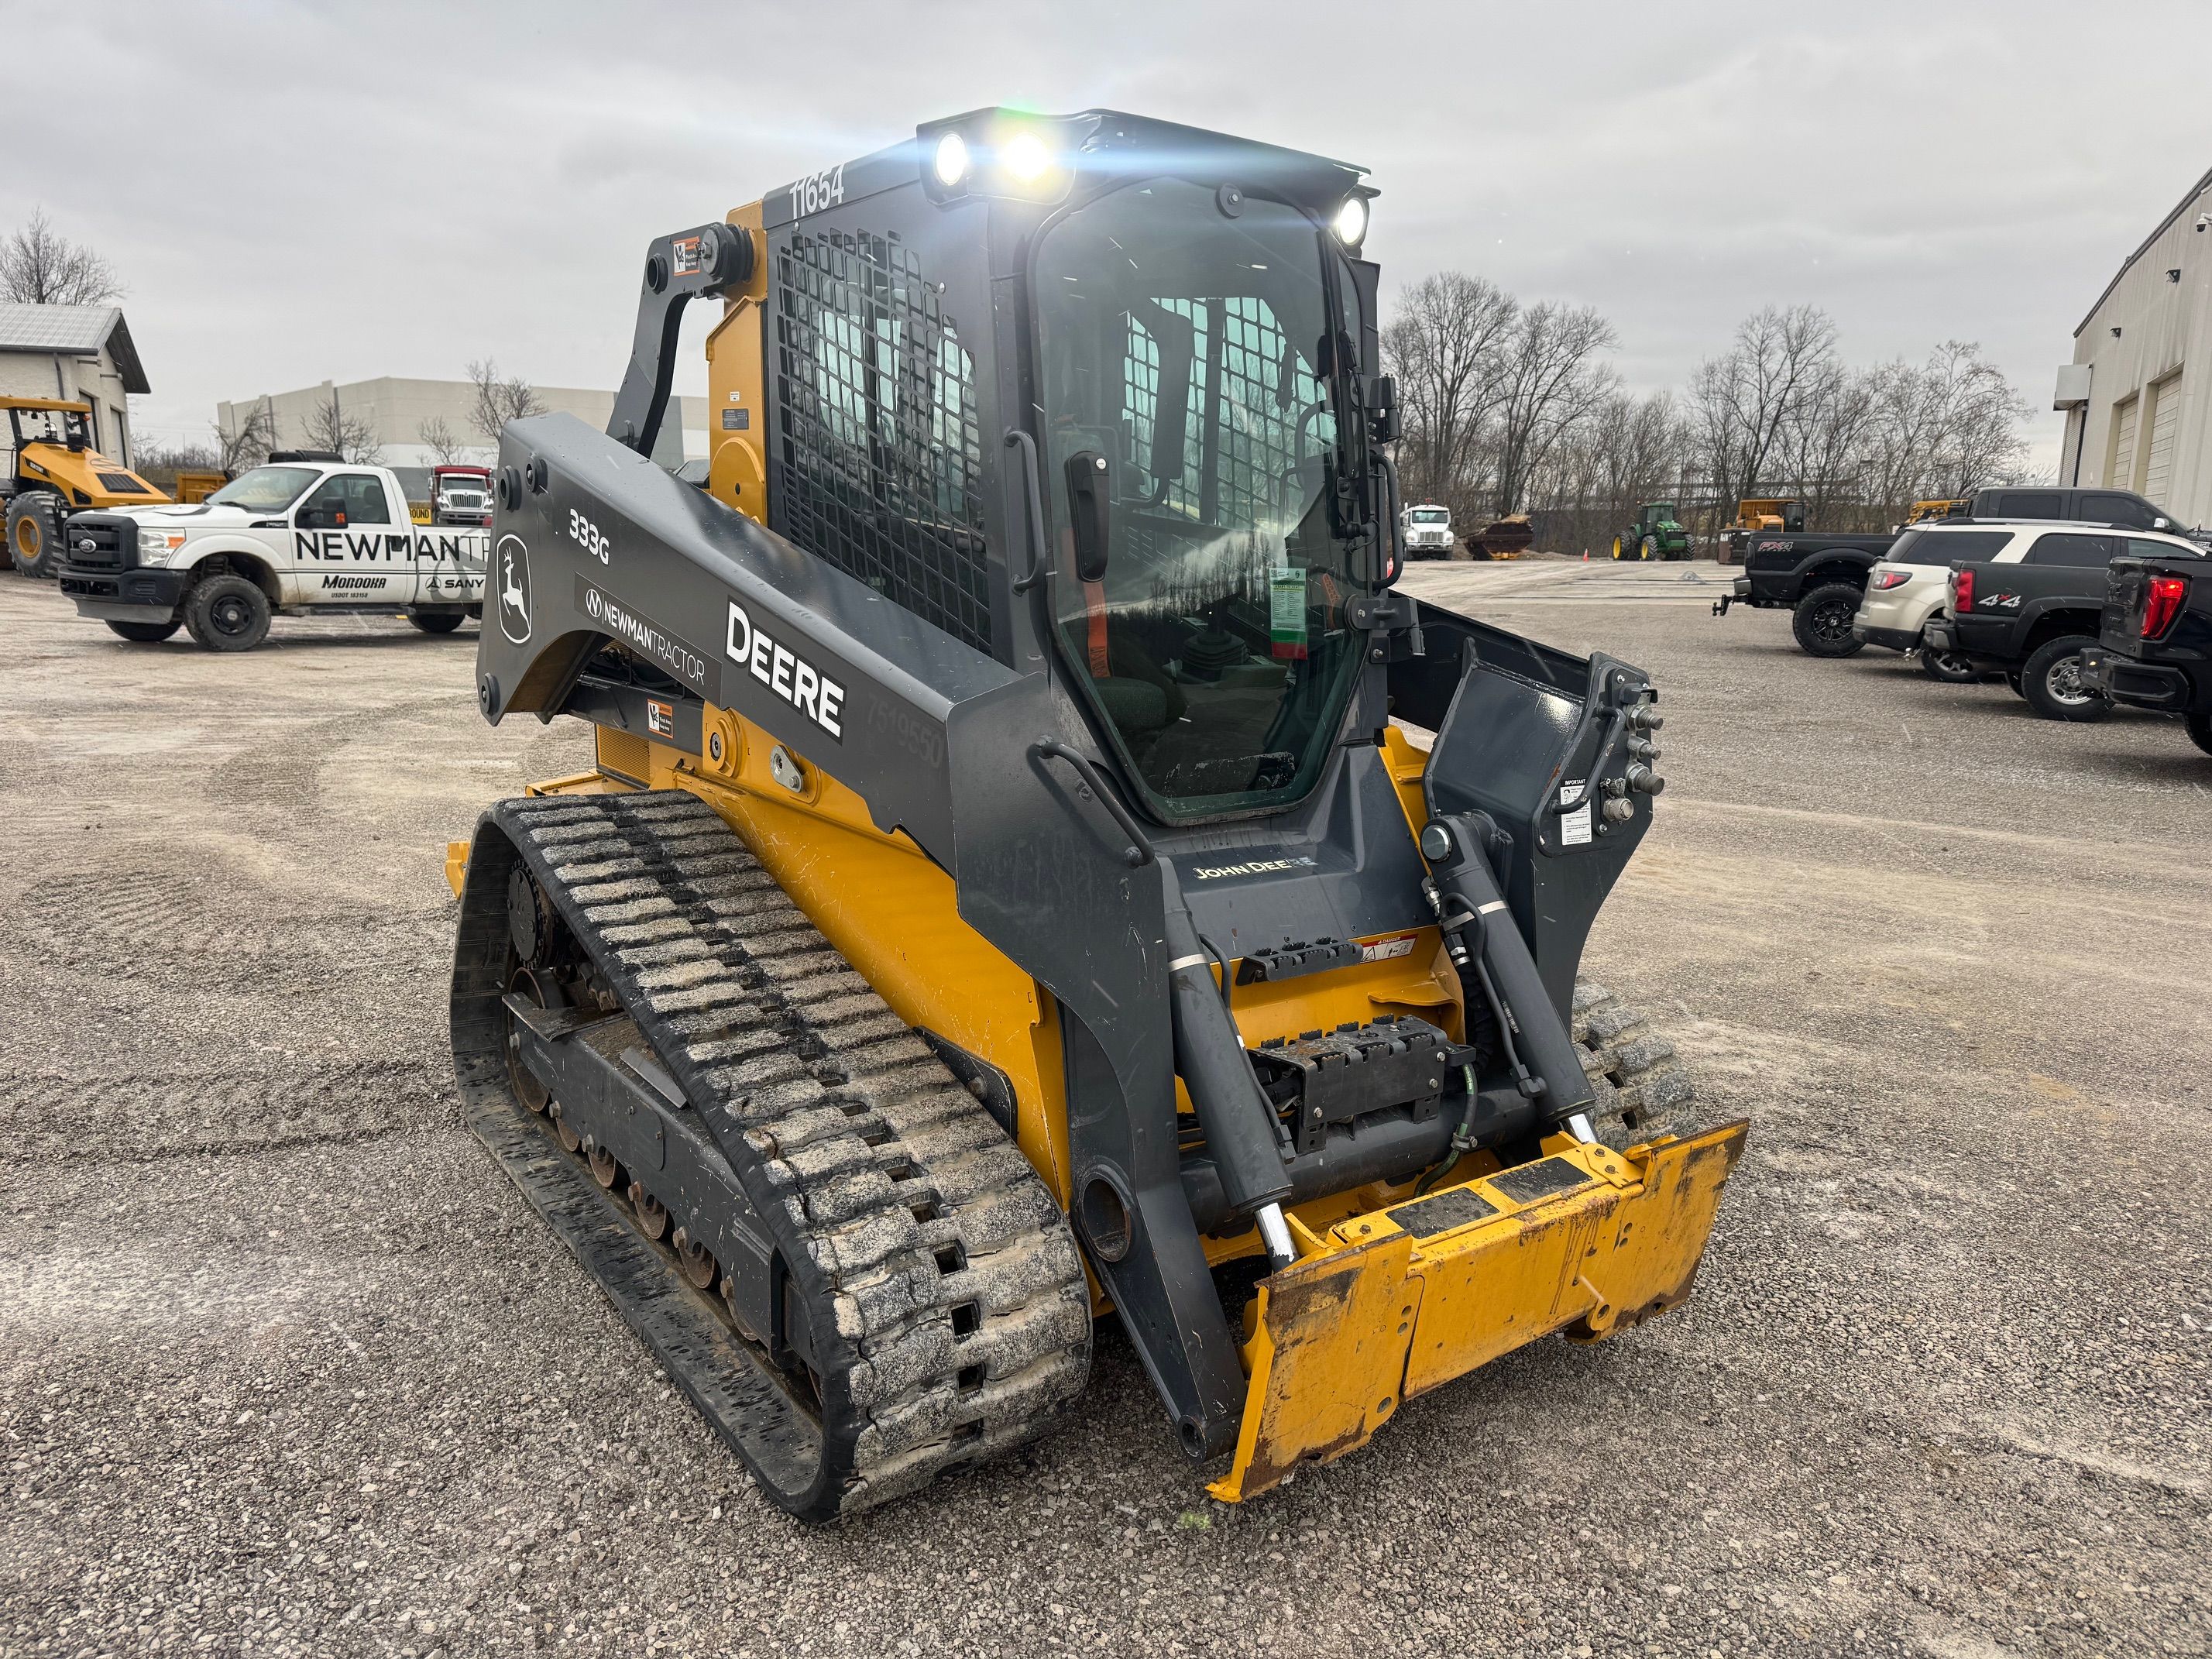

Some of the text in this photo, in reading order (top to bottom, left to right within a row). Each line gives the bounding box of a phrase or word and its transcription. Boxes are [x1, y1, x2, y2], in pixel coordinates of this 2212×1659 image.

[789, 163, 844, 220] 11654
[569, 508, 610, 565] 333G
[1759, 541, 1794, 550] FX4
[445, 579, 484, 589] SANY
[604, 600, 705, 685] NEWMANTRACTOR
[726, 601, 844, 737] DEERE
[1193, 866, 1251, 879] JOHN
